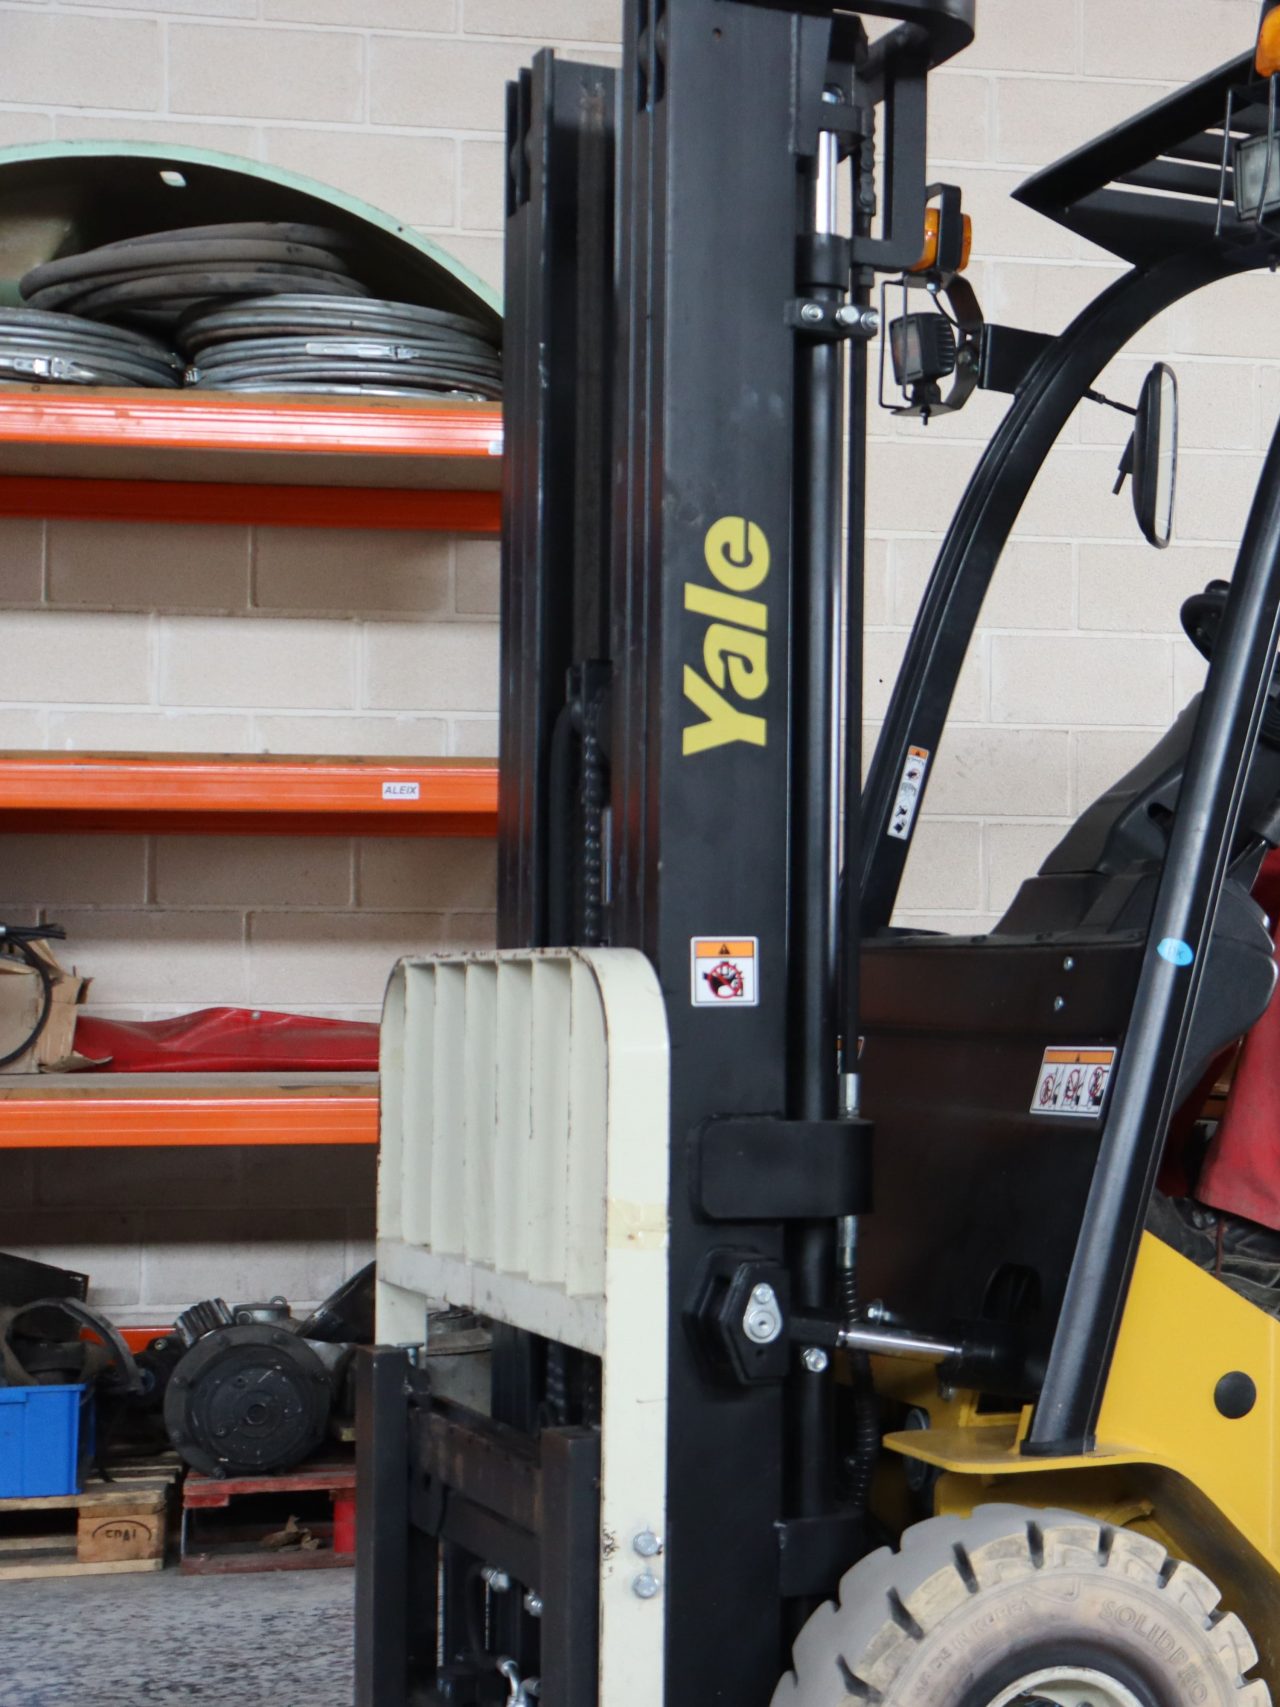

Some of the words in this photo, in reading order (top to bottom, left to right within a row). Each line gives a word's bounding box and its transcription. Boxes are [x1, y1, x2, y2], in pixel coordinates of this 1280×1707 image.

[682, 516, 771, 757] Yale
[385, 785, 417, 795] ALEIX
[1098, 1599, 1209, 1705] SOLIDPRO
